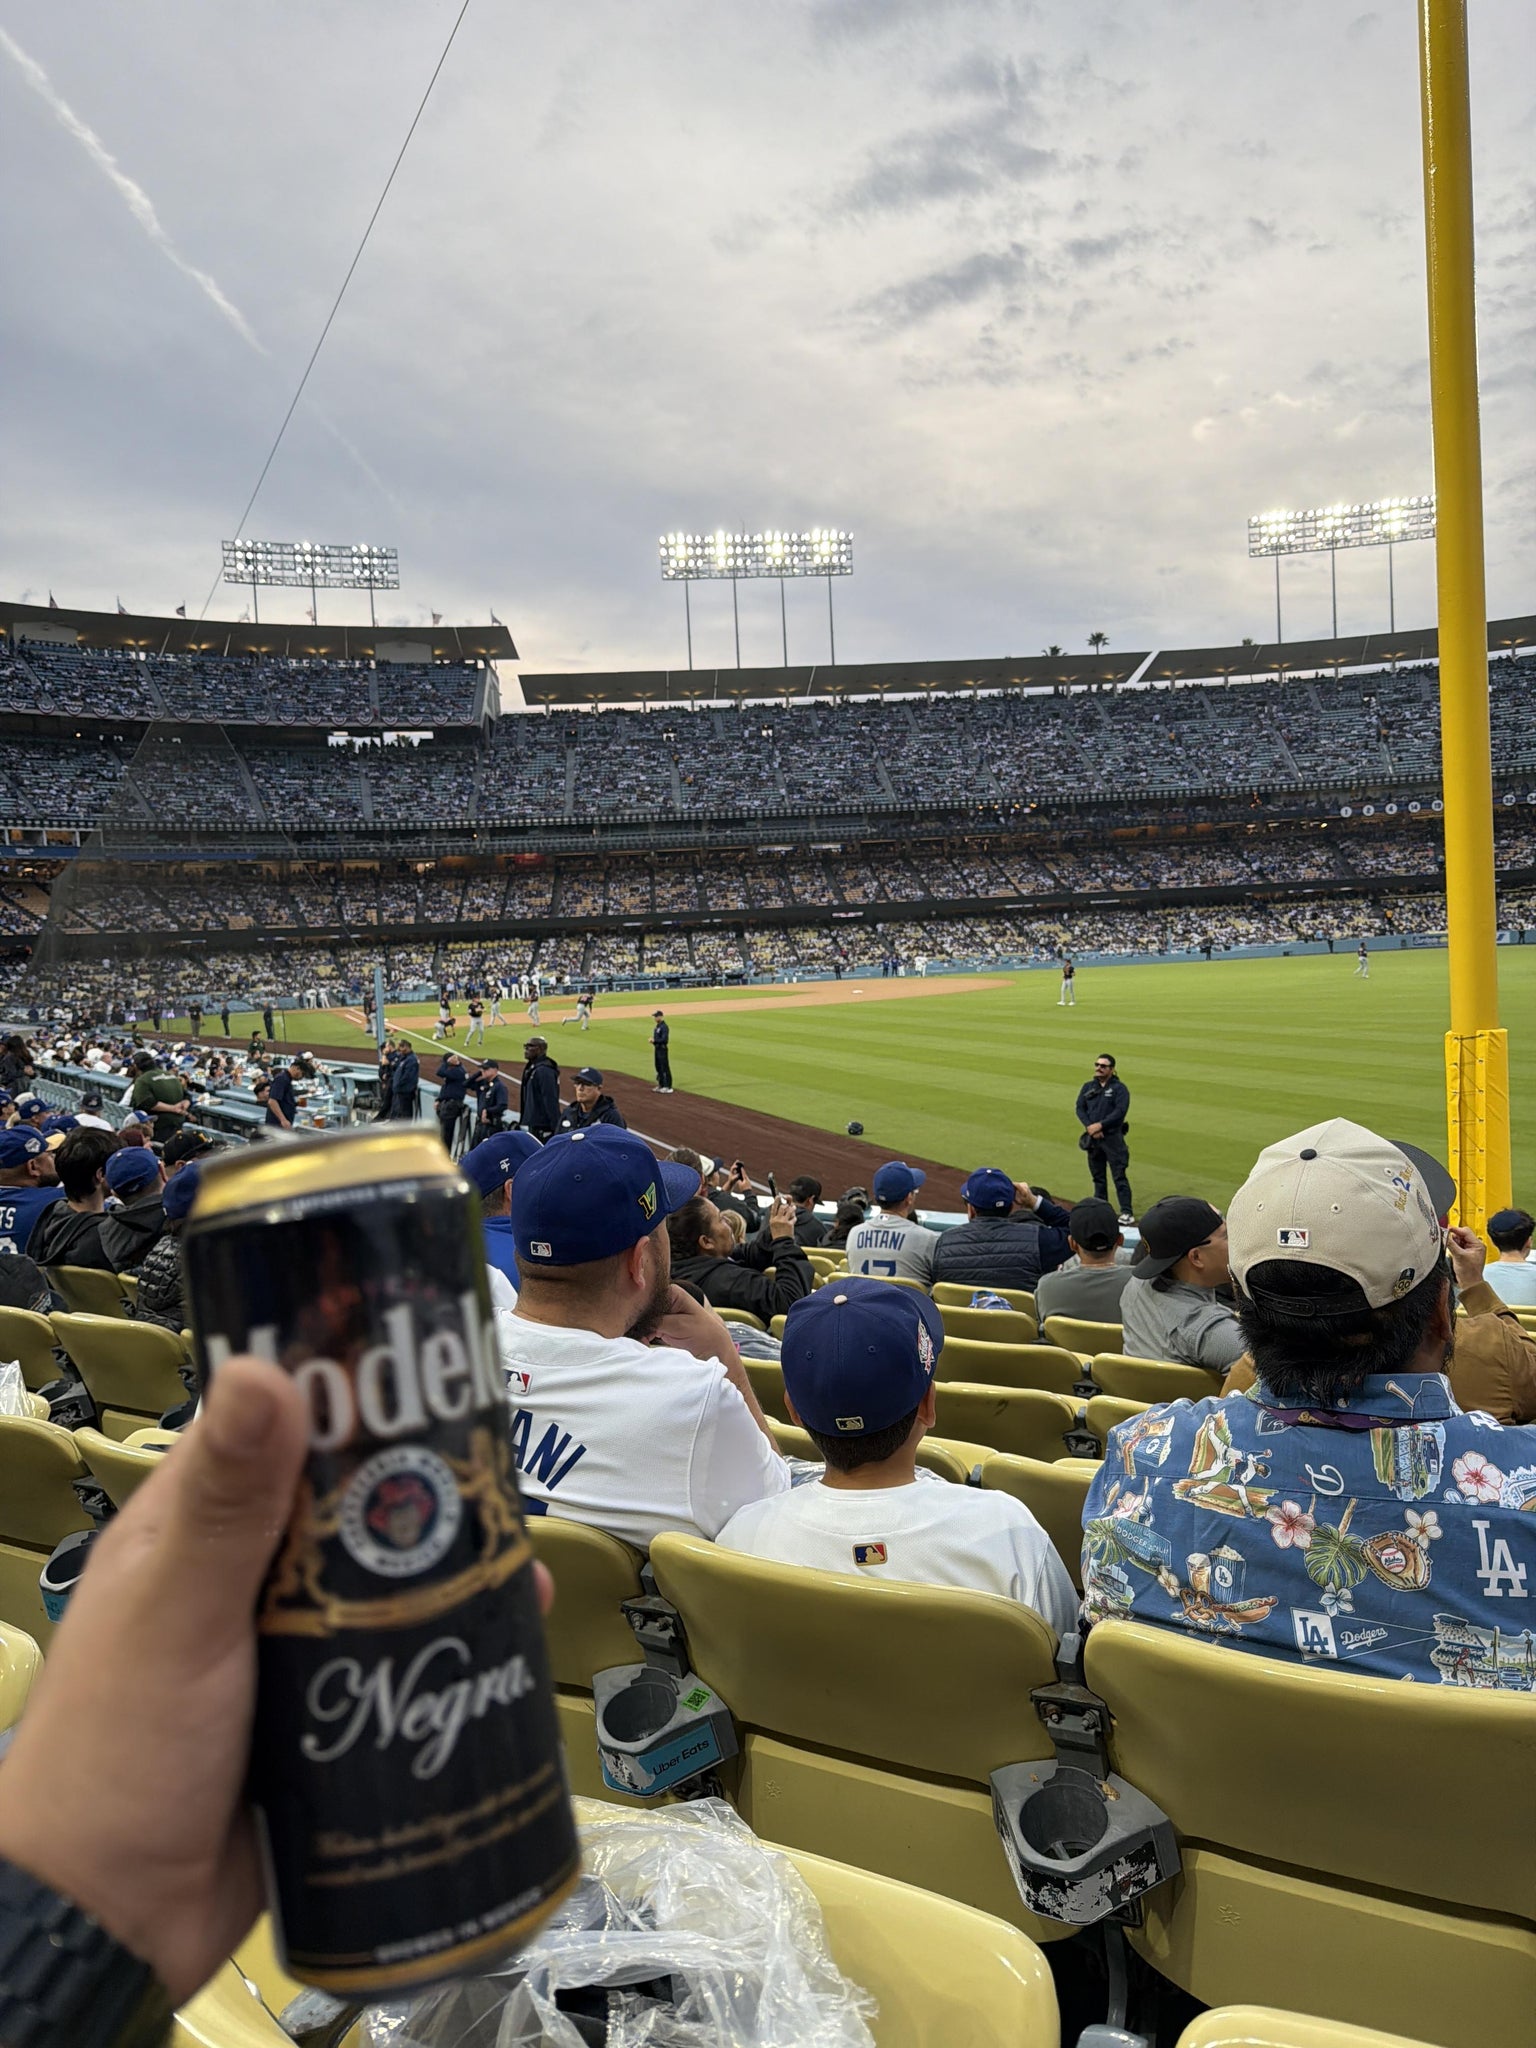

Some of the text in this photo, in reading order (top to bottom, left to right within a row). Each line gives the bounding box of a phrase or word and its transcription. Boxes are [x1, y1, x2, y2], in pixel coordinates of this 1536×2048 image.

[1392, 1176, 1411, 1192] 2
[856, 1229, 906, 1251] OHTANI
[205, 1289, 506, 1451] odel
[1471, 1519, 1528, 1598] LA
[1299, 1616, 1331, 1656] LA
[1340, 1627, 1388, 1648] Dodgers
[300, 1636, 530, 1780] Negra
[652, 1739, 710, 1776] Uber Eats
